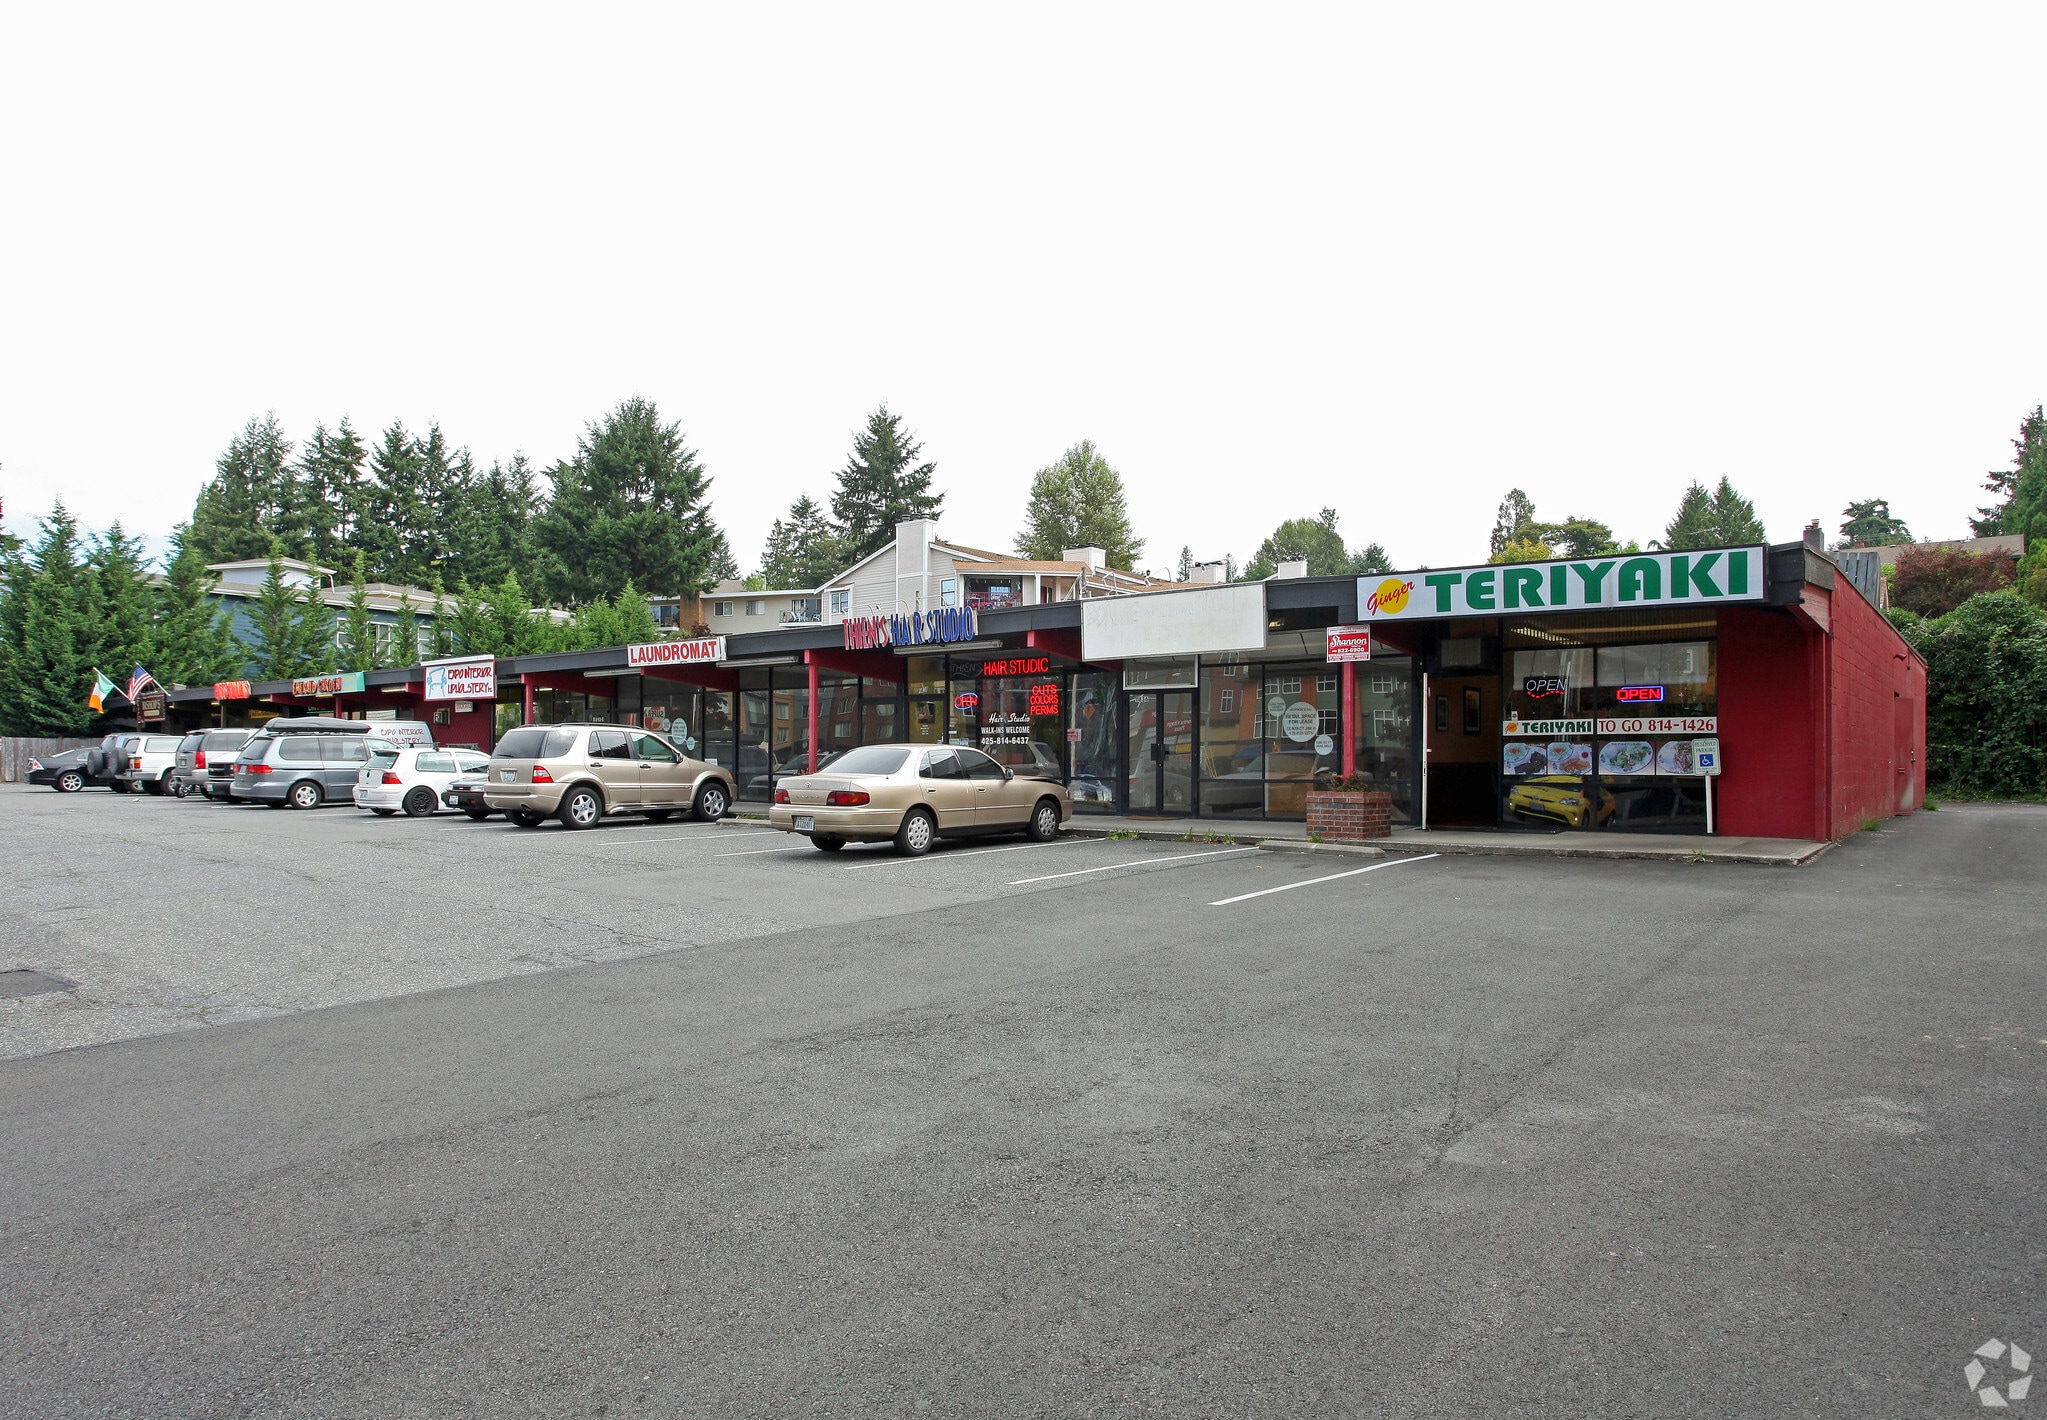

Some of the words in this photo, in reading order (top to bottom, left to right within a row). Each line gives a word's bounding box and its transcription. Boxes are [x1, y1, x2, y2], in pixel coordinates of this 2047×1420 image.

[1425, 551, 1748, 612] TERIYAKI
[1367, 581, 1415, 616] Ginger
[842, 615, 889, 650] THIEN'S
[926, 606, 974, 642] STUDIO
[1330, 634, 1367, 649] Shannon
[630, 641, 717, 663] LAUNDROMAT
[983, 660, 1008, 676] HAIR
[1031, 684, 1058, 695] CUTS
[1526, 679, 1568, 691] OPEN
[1029, 694, 1059, 705] COLORS
[1616, 688, 1661, 700] OPEN
[954, 694, 979, 707] OPEN
[1030, 704, 1059, 715] PERMS
[988, 712, 1003, 723] Hair
[1007, 712, 1031, 723] Studio
[981, 726, 1004, 734] WALK-INS
[1005, 726, 1030, 734] WELCOME
[1522, 721, 1592, 733] TERIYAKI
[1598, 720, 1616, 733] TO
[1621, 719, 1643, 733] GO
[1648, 719, 1715, 732] 814-1426
[981, 736, 1029, 745] 425-814-6437
